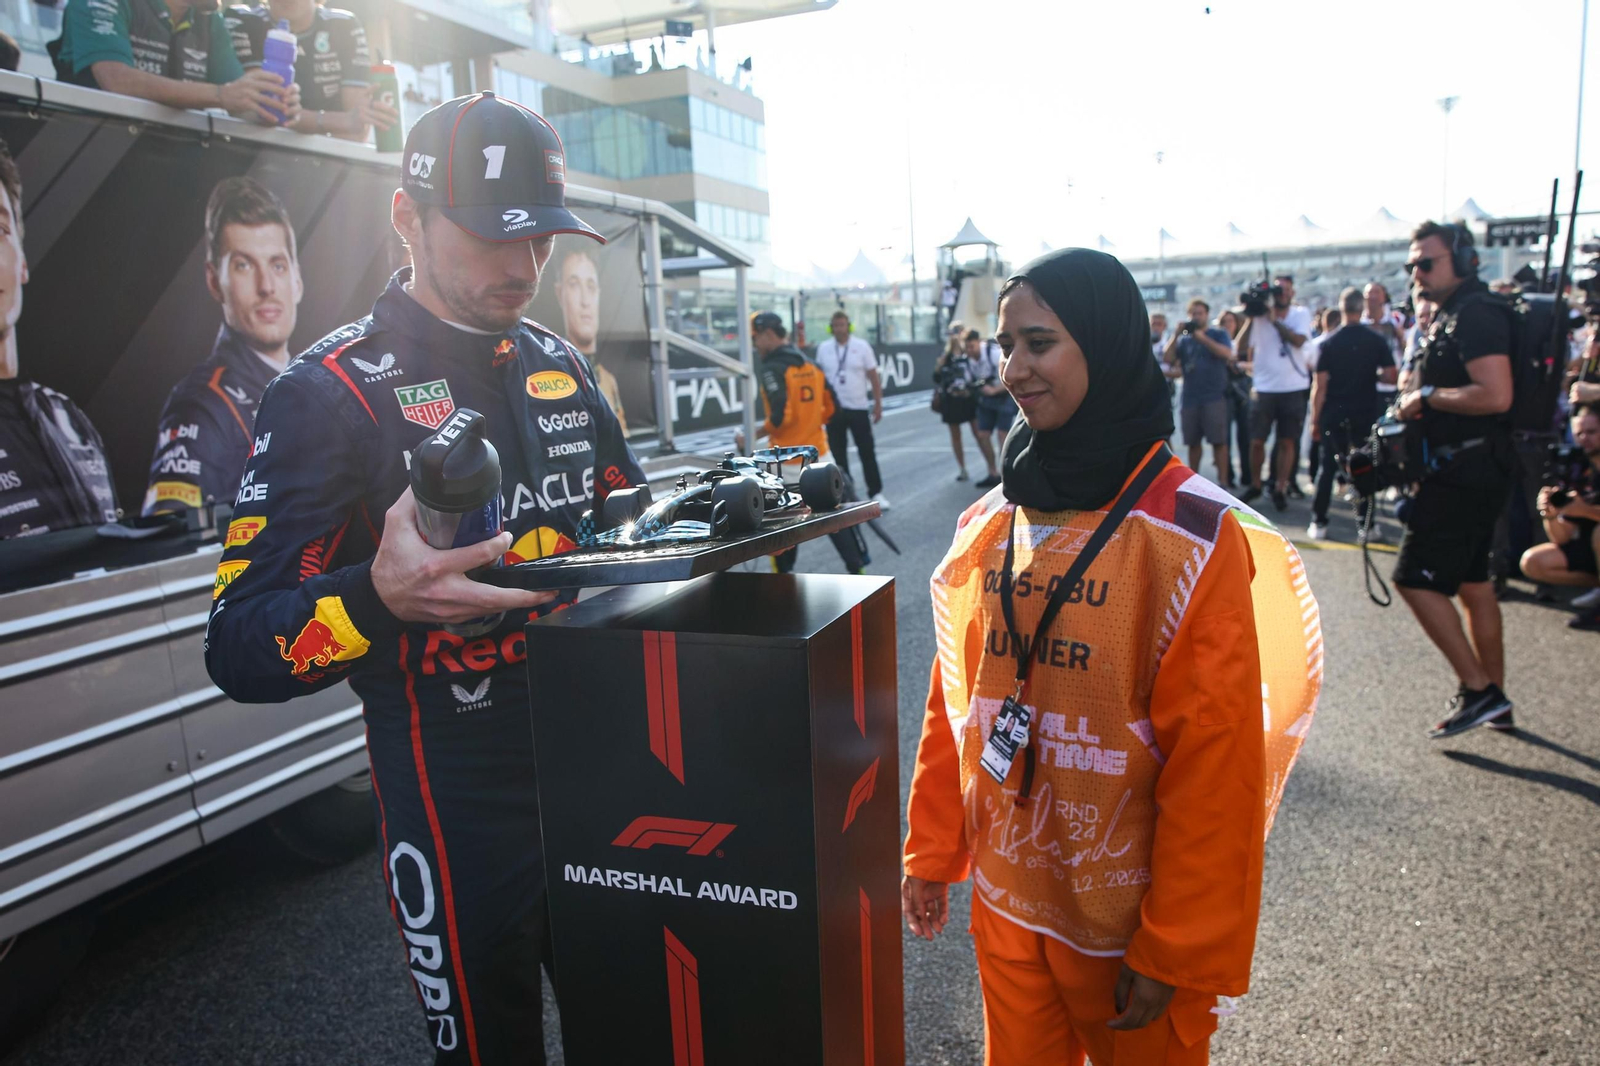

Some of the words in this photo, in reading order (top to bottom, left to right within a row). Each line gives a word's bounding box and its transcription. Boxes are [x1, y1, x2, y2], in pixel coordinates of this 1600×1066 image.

[482, 145, 506, 179] 1
[503, 220, 537, 232] viaplay
[364, 368, 404, 383] CASTORE
[536, 379, 571, 392] RAUCH
[400, 383, 449, 404] TAG
[404, 400, 452, 428] HEUER
[431, 412, 473, 447] YETI
[247, 432, 271, 459] bil
[547, 441, 591, 457] HONDA
[0, 470, 22, 492] BS
[502, 466, 595, 521] ACLE
[985, 629, 1092, 672] UNNER
[456, 699, 493, 713] CASTORE
[1055, 800, 1103, 823] RND.
[1068, 821, 1097, 841] 24
[564, 864, 691, 897] MARSHAL
[697, 881, 798, 910] AWARD
